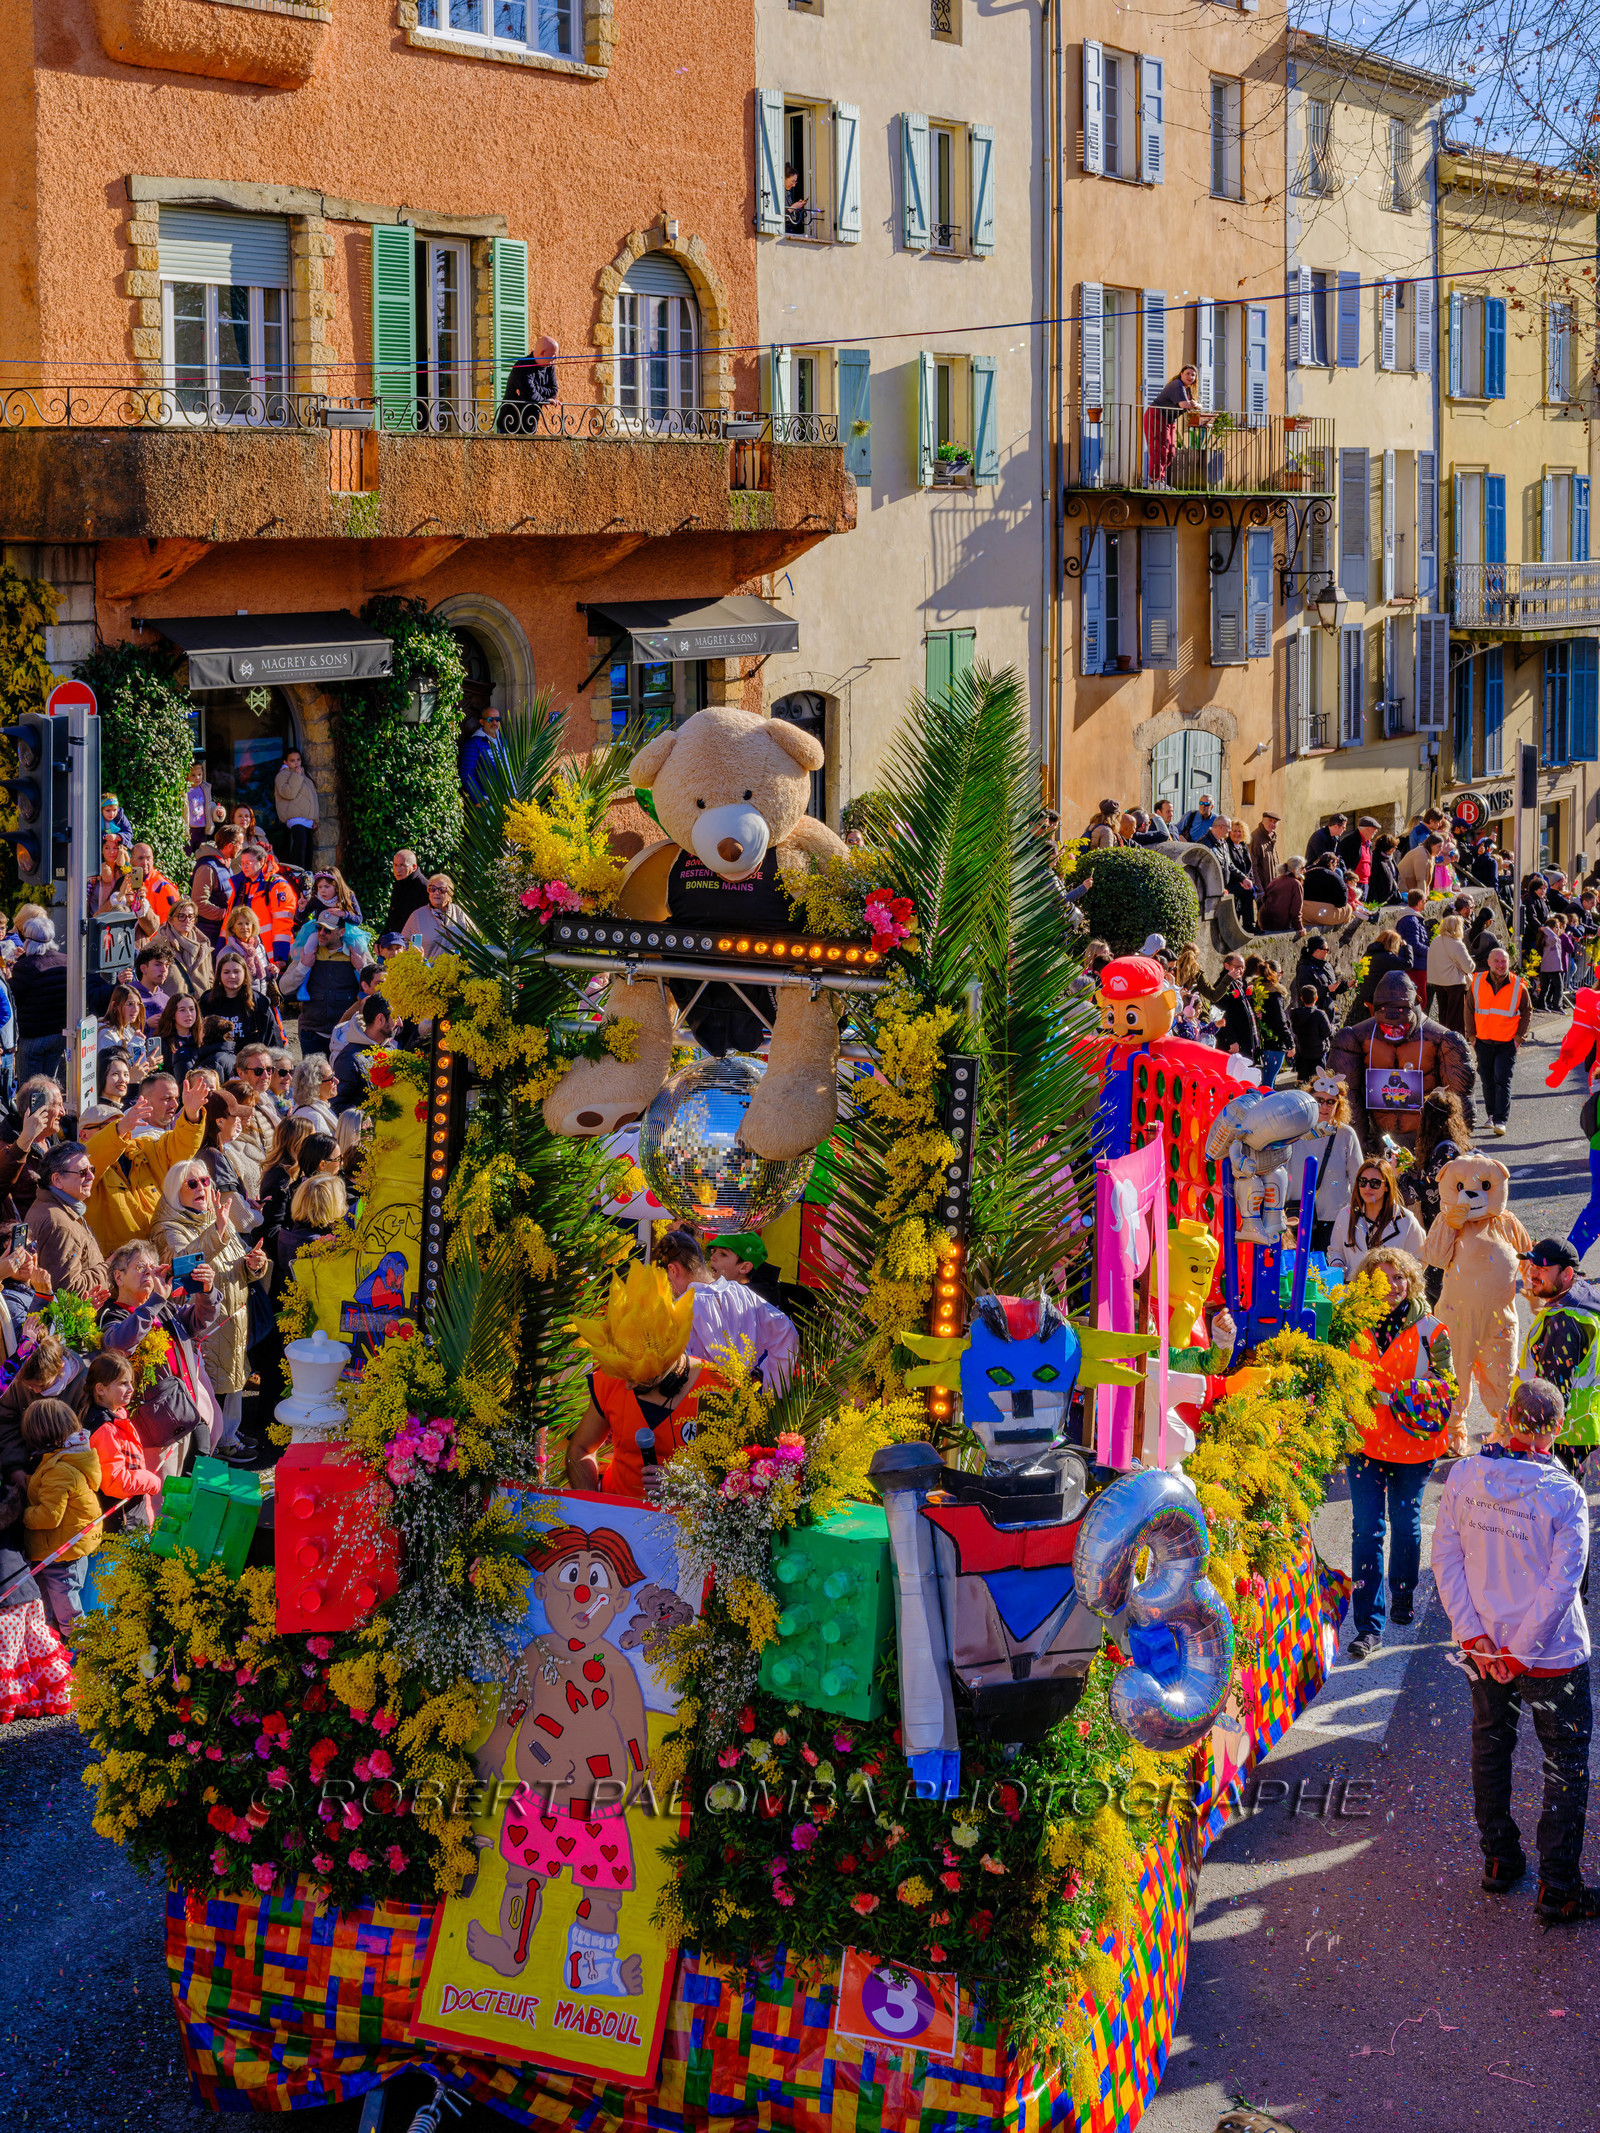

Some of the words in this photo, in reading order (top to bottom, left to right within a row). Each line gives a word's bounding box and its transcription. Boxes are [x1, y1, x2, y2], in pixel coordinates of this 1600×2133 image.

[695, 635, 728, 646] MAGREY
[729, 635, 736, 644] &
[737, 633, 758, 644] SONS
[261, 656, 306, 670] MAGREY
[309, 655, 318, 667] &
[320, 653, 348, 666] SONS
[1456, 794, 1480, 805] BARNES
[1462, 803, 1475, 821] B
[680, 870, 714, 879] RESTENT
[686, 880, 720, 889] BONNES
[722, 882, 754, 891] MAINS
[1465, 1496, 1492, 1510] Réerve
[1492, 1502, 1537, 1521] Communale
[1468, 1519, 1477, 1528] de
[1506, 1529, 1529, 1541] Civile
[872, 1969, 919, 2033] 3
[439, 1983, 541, 2029] DOCTEUR
[553, 1999, 643, 2047] MABOUL
